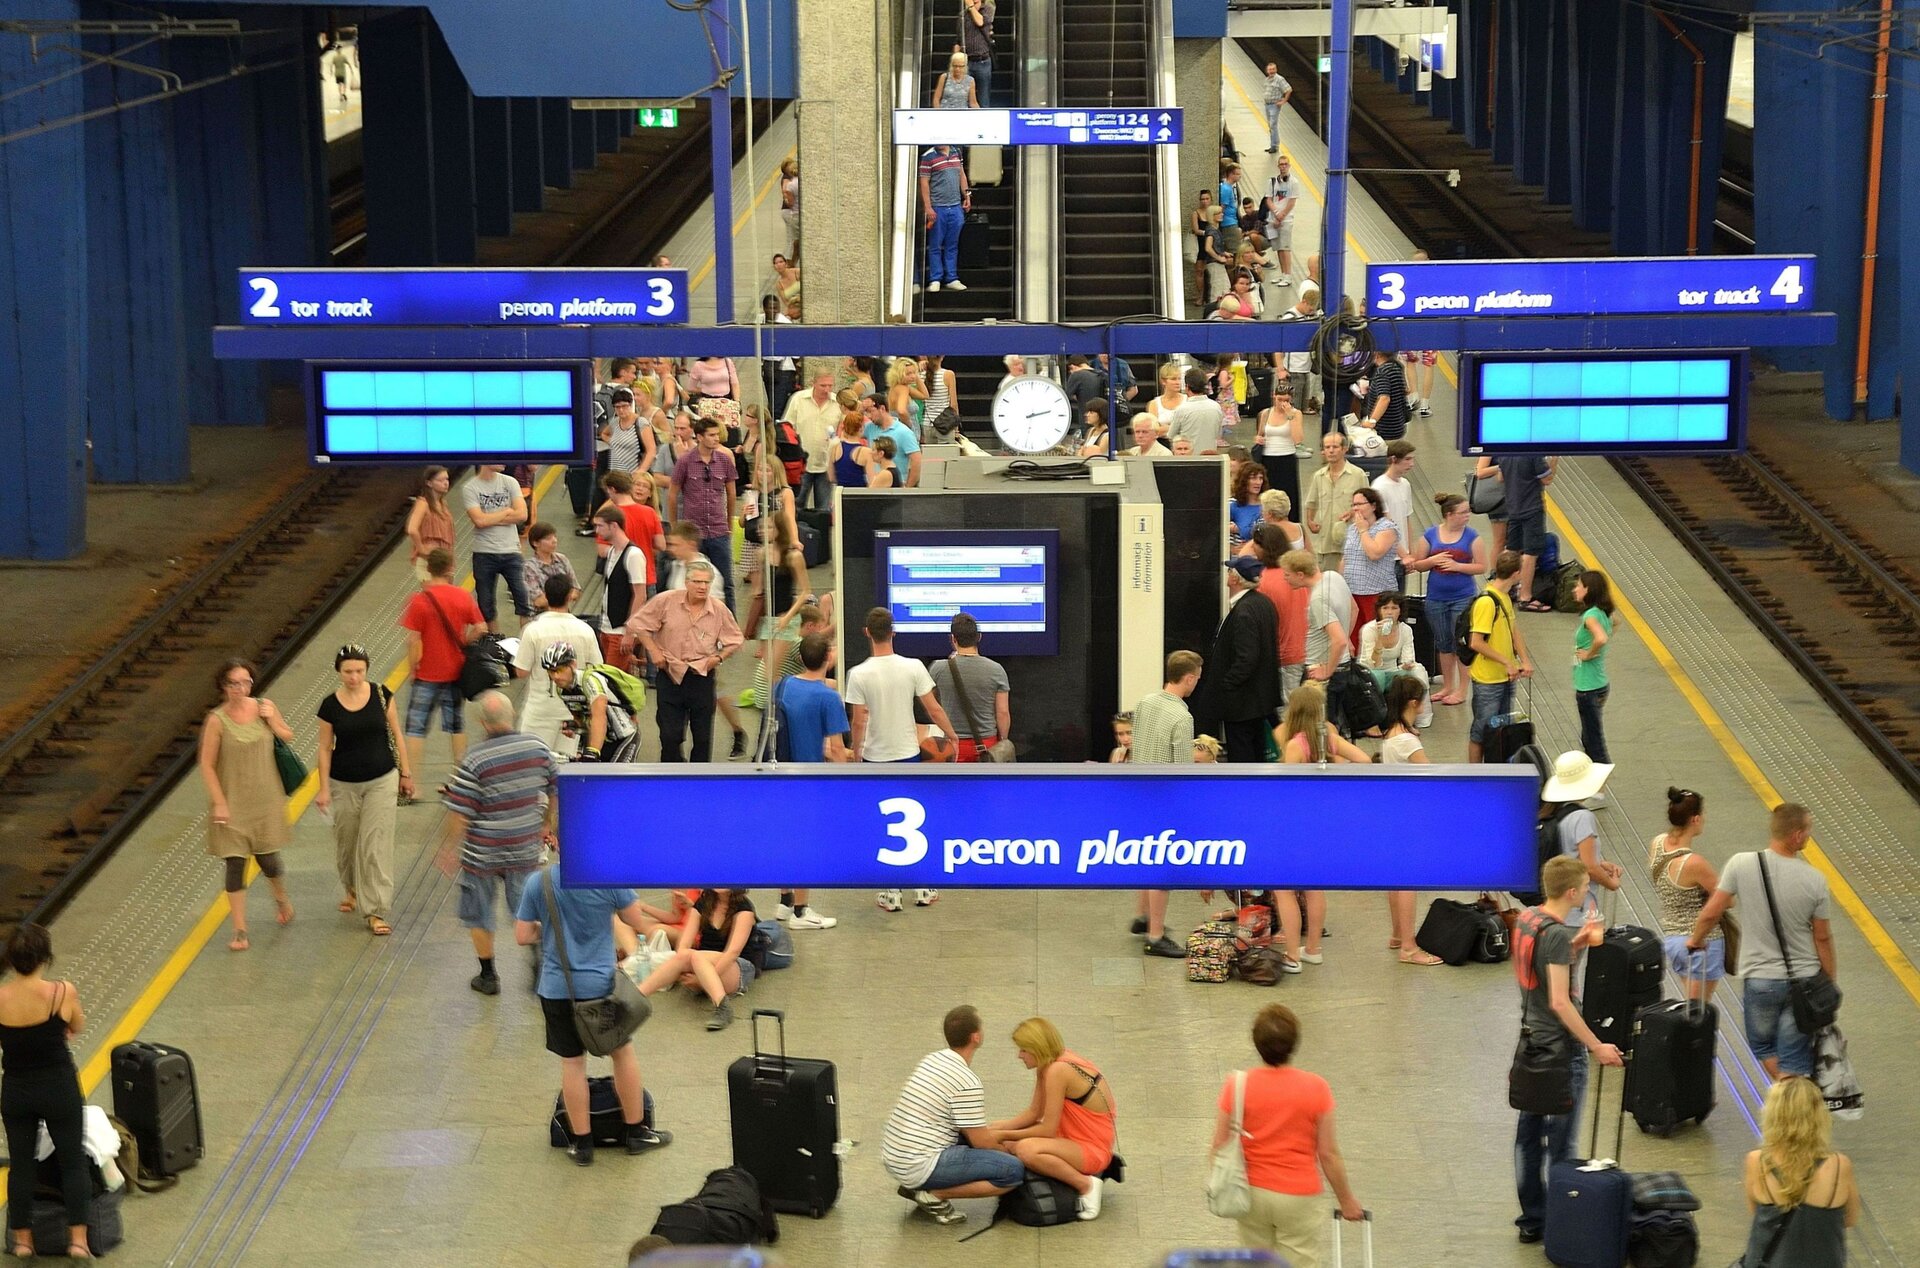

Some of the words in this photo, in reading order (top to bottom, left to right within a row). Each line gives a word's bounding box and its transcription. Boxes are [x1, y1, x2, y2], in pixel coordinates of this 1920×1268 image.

[249, 278, 280, 317] 2
[290, 301, 320, 317] tor
[327, 298, 372, 316] track
[500, 303, 553, 320] peron
[560, 298, 636, 320] platform
[647, 278, 674, 316] 3
[1377, 273, 1405, 309] 3
[1415, 296, 1469, 313] peron
[1474, 290, 1552, 312] platform
[1678, 290, 1708, 305] tor
[1714, 286, 1761, 304] track
[1770, 266, 1803, 303] 4
[1144, 542, 1152, 593] information
[877, 798, 928, 865] 3
[944, 839, 1059, 873] peron
[1077, 830, 1246, 873] platform
